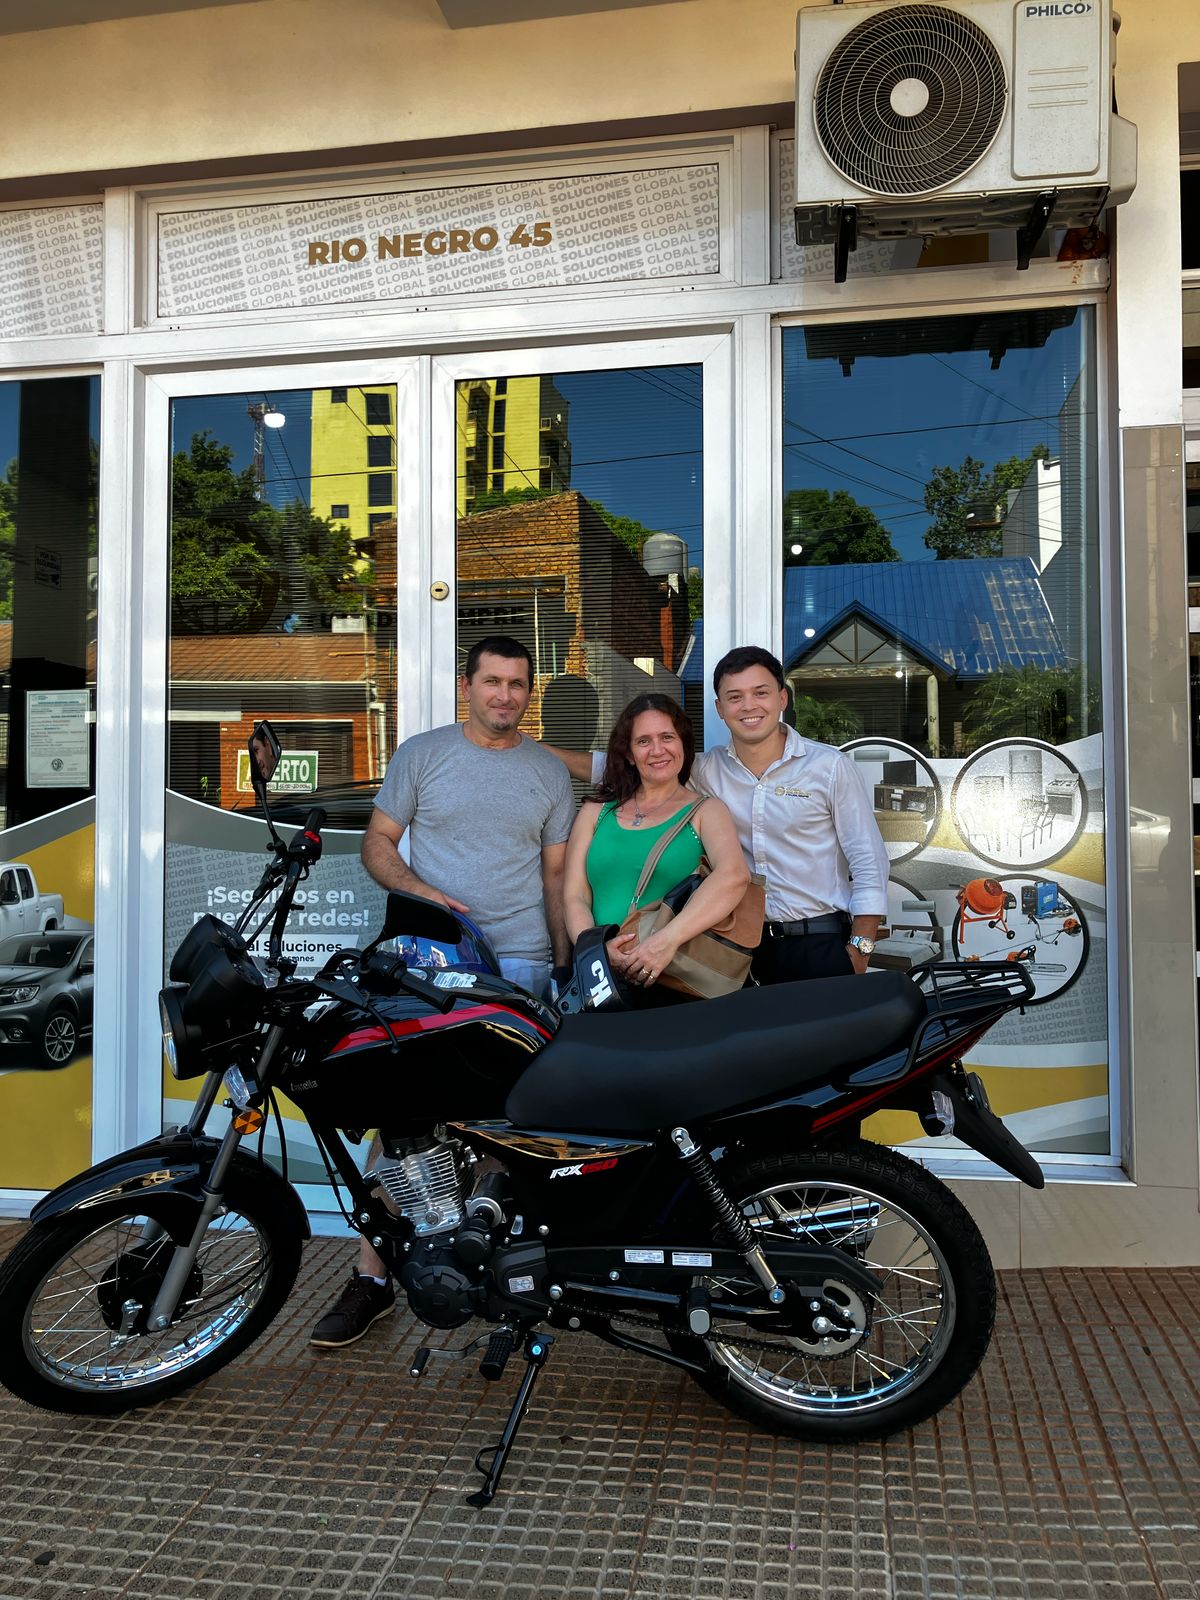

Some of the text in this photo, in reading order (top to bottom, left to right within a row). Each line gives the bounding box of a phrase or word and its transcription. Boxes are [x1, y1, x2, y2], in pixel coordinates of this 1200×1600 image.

[1026, 3, 1086, 17] PHILCO
[418, 201, 495, 228] SOLUCIONES
[497, 187, 546, 206] GLOBAL
[499, 199, 548, 217] GLOBAL
[550, 176, 630, 204] SOLUCIONES
[501, 174, 685, 229] GLOBAL SOLUCIONES GLOBAL
[554, 186, 688, 227] SOLUCIONES GLOBAL
[36, 210, 77, 228] GLOBAL
[37, 221, 79, 239] GLOBAL
[163, 213, 234, 239] SOLUCIONES
[165, 224, 236, 250] SOLUCIONES
[239, 211, 284, 229] GLOBAL
[167, 235, 238, 261] SOLUCIONES
[240, 222, 286, 241] GLOBAL
[288, 201, 361, 228] SOLUCIONES
[556, 197, 690, 239] SOLUCIONES GLOBAL
[39, 231, 80, 250] GLOBAL
[169, 246, 240, 272] SOLUCIONES
[242, 234, 288, 252] GLOBAL
[290, 213, 363, 239] SOLUCIONES
[365, 200, 413, 218] GLOBAL
[171, 258, 242, 283] SOLUCIONES
[244, 245, 290, 263] GLOBAL
[367, 211, 415, 229] GLOBAL
[416, 190, 493, 216] SOLUCIONES
[308, 221, 552, 266] RIO NEGRO 45
[510, 257, 559, 275] GLOBAL
[561, 235, 641, 262] SOLUCIONES
[643, 221, 694, 241] GLOBAL
[41, 243, 82, 261] GLOBAL
[42, 254, 84, 272] GLOBAL
[380, 279, 427, 297] GLOBAL
[428, 258, 505, 285] SOLUCIONES
[559, 224, 638, 251] SOLUCIONES
[641, 209, 692, 229] GLOBAL
[512, 233, 697, 286] GLOBAL SOLUCIONES GLOBAL
[647, 245, 699, 264] GLOBAL
[44, 265, 85, 283] GLOBAL
[173, 256, 292, 294] SOLUCIONES GLOBAL
[649, 257, 701, 276] GLOBAL
[46, 276, 87, 295] GLOBAL
[174, 267, 294, 305] SOLUCIONES GLOBAL
[250, 278, 296, 296] GLOBAL
[252, 290, 298, 308] GLOBAL
[299, 269, 373, 295] SOLUCIONES
[376, 256, 423, 274] GLOBAL
[301, 280, 375, 305] SOLUCIONES
[378, 268, 425, 286] GLOBAL
[48, 288, 89, 306] GLOBAL
[49, 298, 91, 317] GLOBAL
[51, 310, 93, 328] GLOBAL
[326, 889, 355, 904] en
[299, 908, 369, 927] redes!
[264, 940, 342, 952] Sluciones
